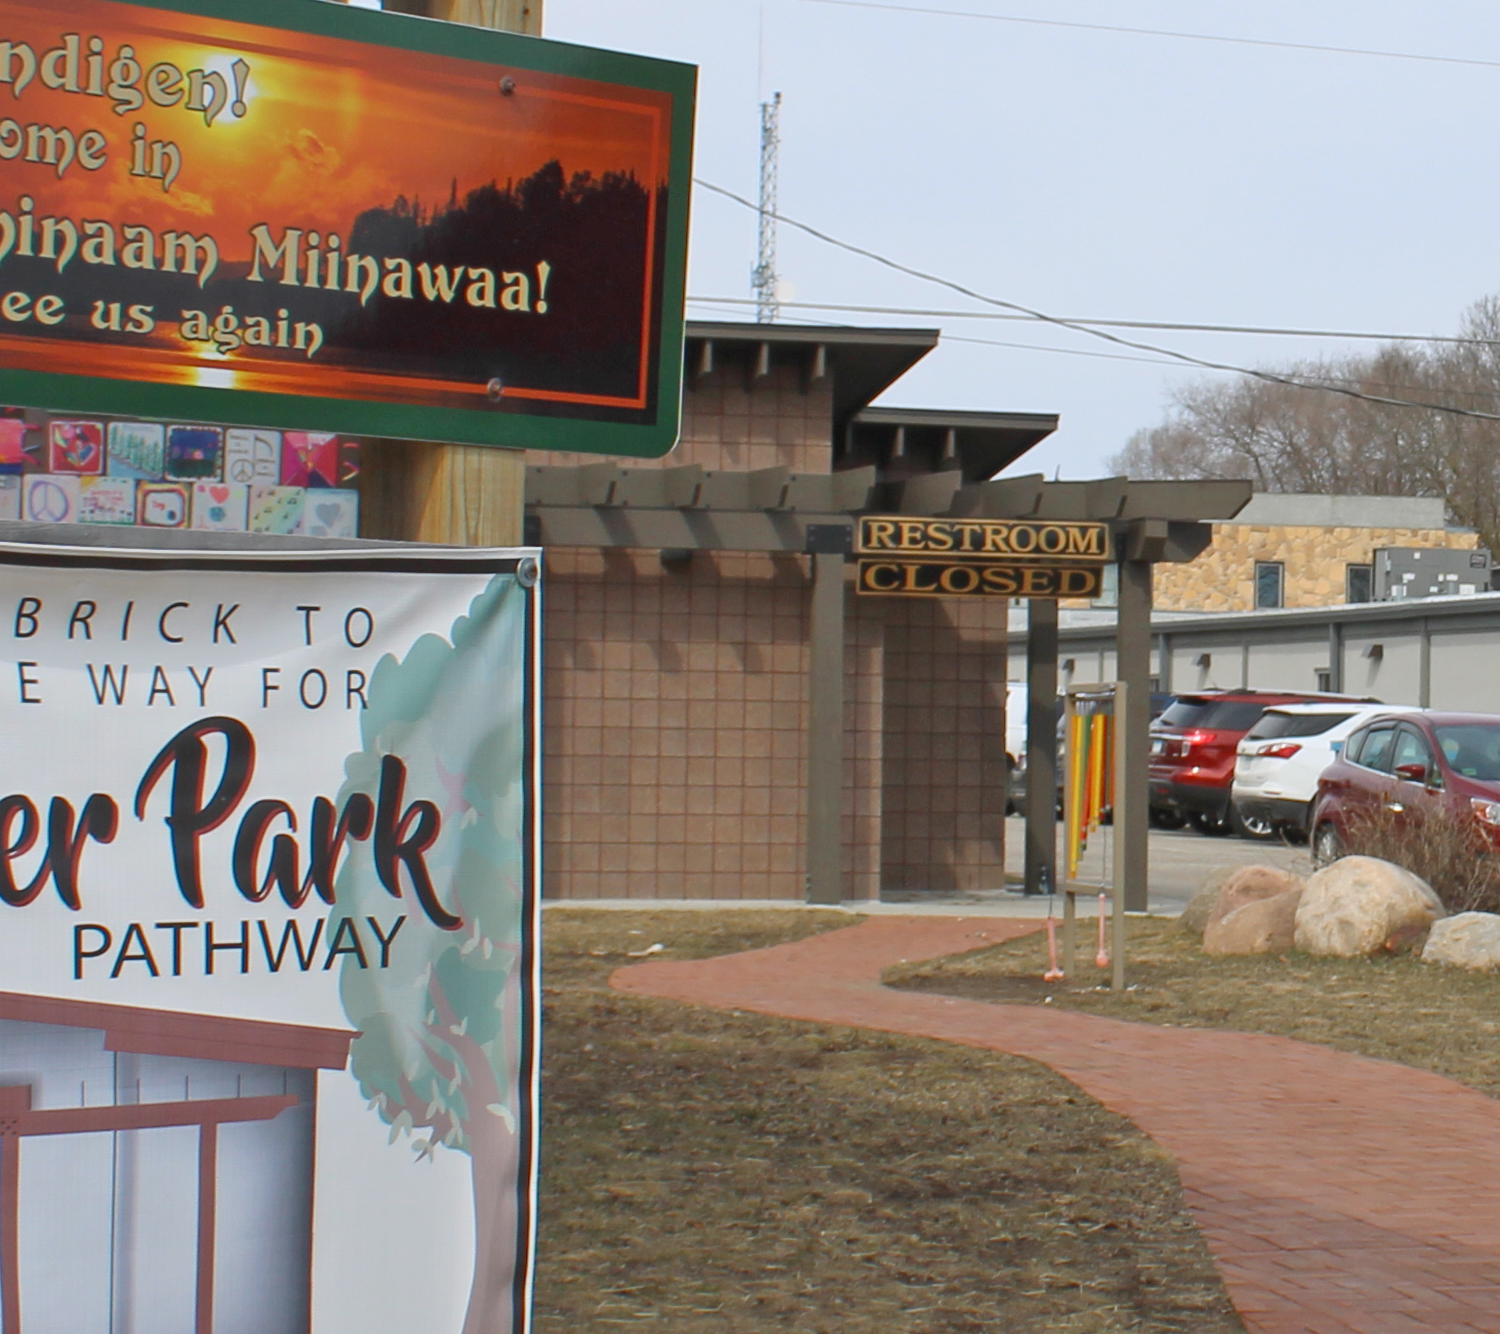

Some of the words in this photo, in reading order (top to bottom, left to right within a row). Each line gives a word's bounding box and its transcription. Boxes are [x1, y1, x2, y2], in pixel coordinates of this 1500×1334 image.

[131, 123, 181, 189] in
[249, 223, 551, 315] Miinawaa!
[91, 290, 154, 334] us
[181, 303, 323, 356] again
[866, 521, 1101, 554] RESTROOM
[864, 564, 1096, 596] CLOSED
[14, 597, 239, 646] BRICK
[300, 605, 376, 648] TO
[86, 663, 213, 708] WAY
[261, 667, 369, 710] FOR
[134, 715, 463, 931] Park
[73, 913, 407, 980] PATHWAY
